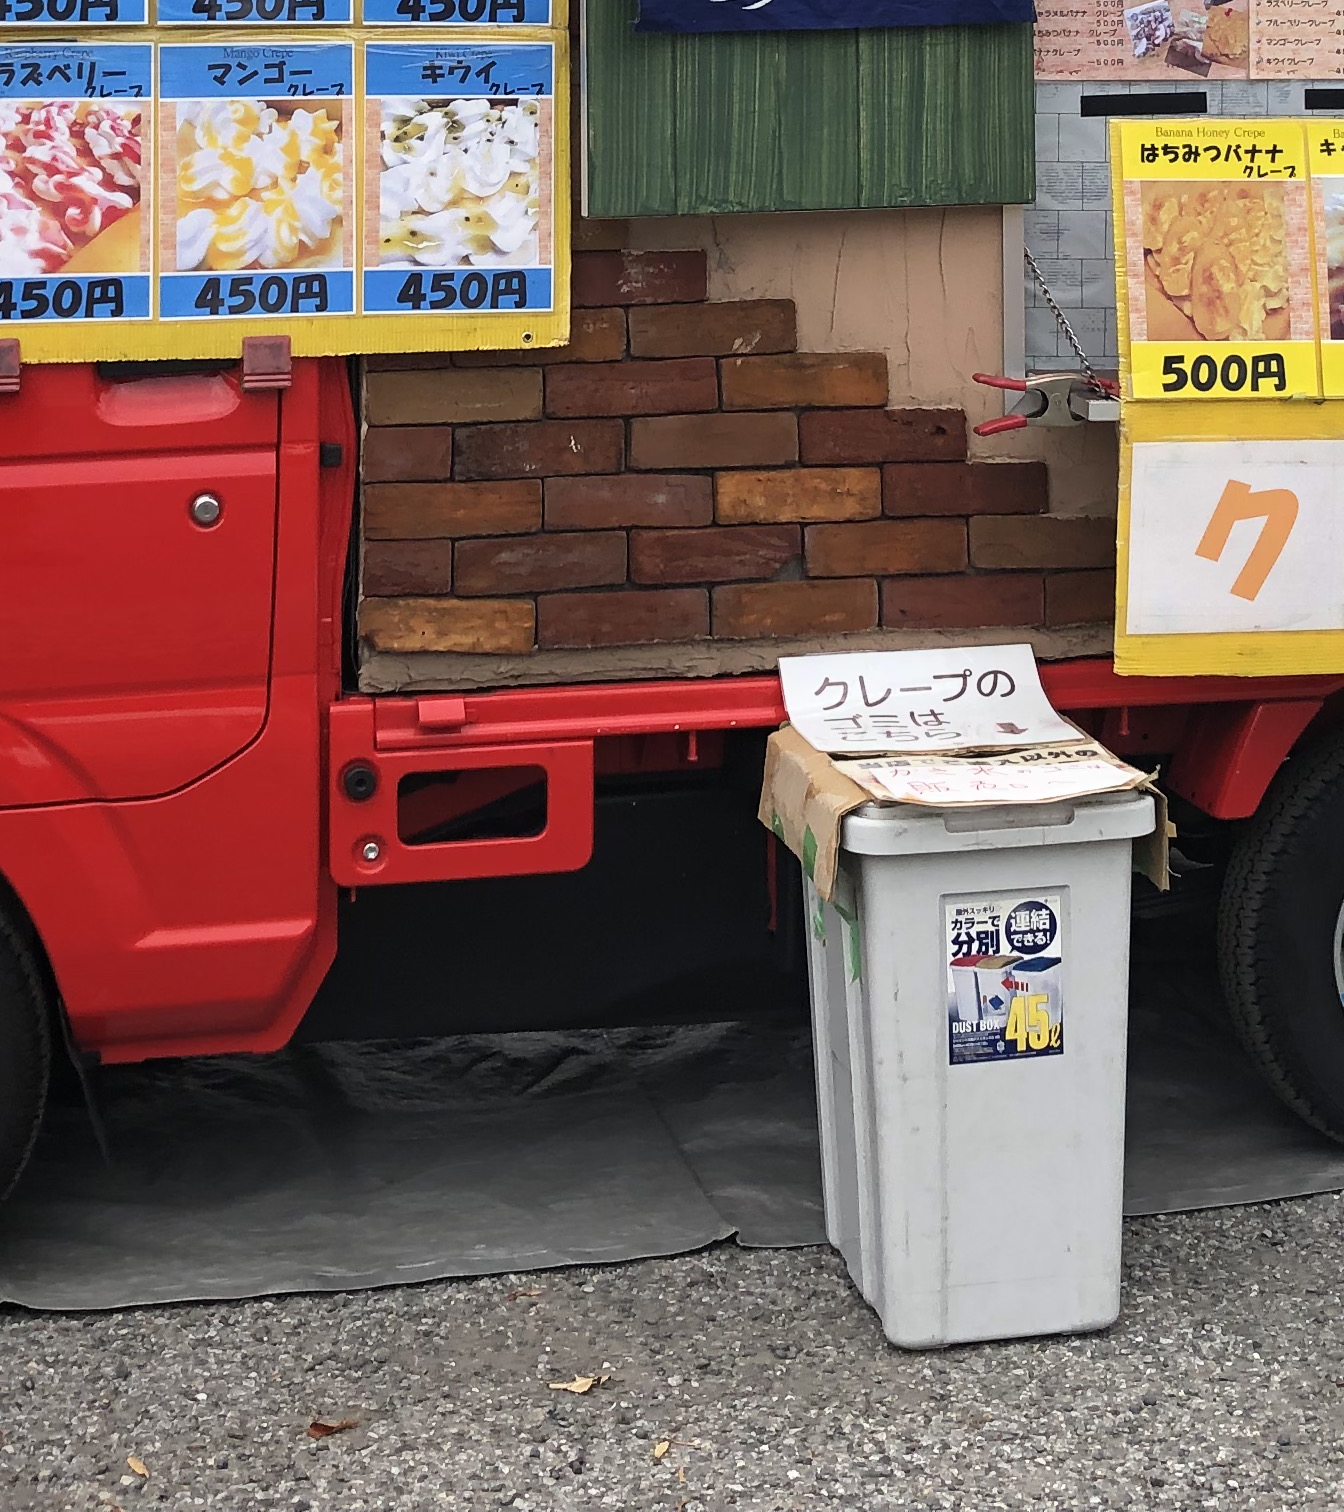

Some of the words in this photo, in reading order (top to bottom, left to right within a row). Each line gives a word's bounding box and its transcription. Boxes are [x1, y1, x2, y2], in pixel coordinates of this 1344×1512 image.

[223, 48, 260, 62] Mango
[262, 47, 294, 61] Crepe
[207, 61, 313, 86] マンゴー
[421, 60, 497, 85] キウイ
[84, 84, 144, 98] クレープ
[287, 83, 345, 97] クレープ
[489, 83, 545, 96] クレープ
[1140, 143, 1284, 163] はちみつバナナ
[1243, 165, 1297, 178] クレープ
[194, 274, 328, 315] 450円
[396, 271, 528, 310] 450円
[1161, 352, 1286, 393] 500円
[814, 667, 1016, 711] クレープの
[823, 708, 951, 731] ゴミは
[839, 728, 962, 743] こちら
[951, 914, 1001, 931] カラーで
[1010, 908, 1050, 932] 連結
[951, 928, 1001, 958] 分別
[953, 1020, 977, 1034] DUST
[980, 1019, 1001, 1031] BOX
